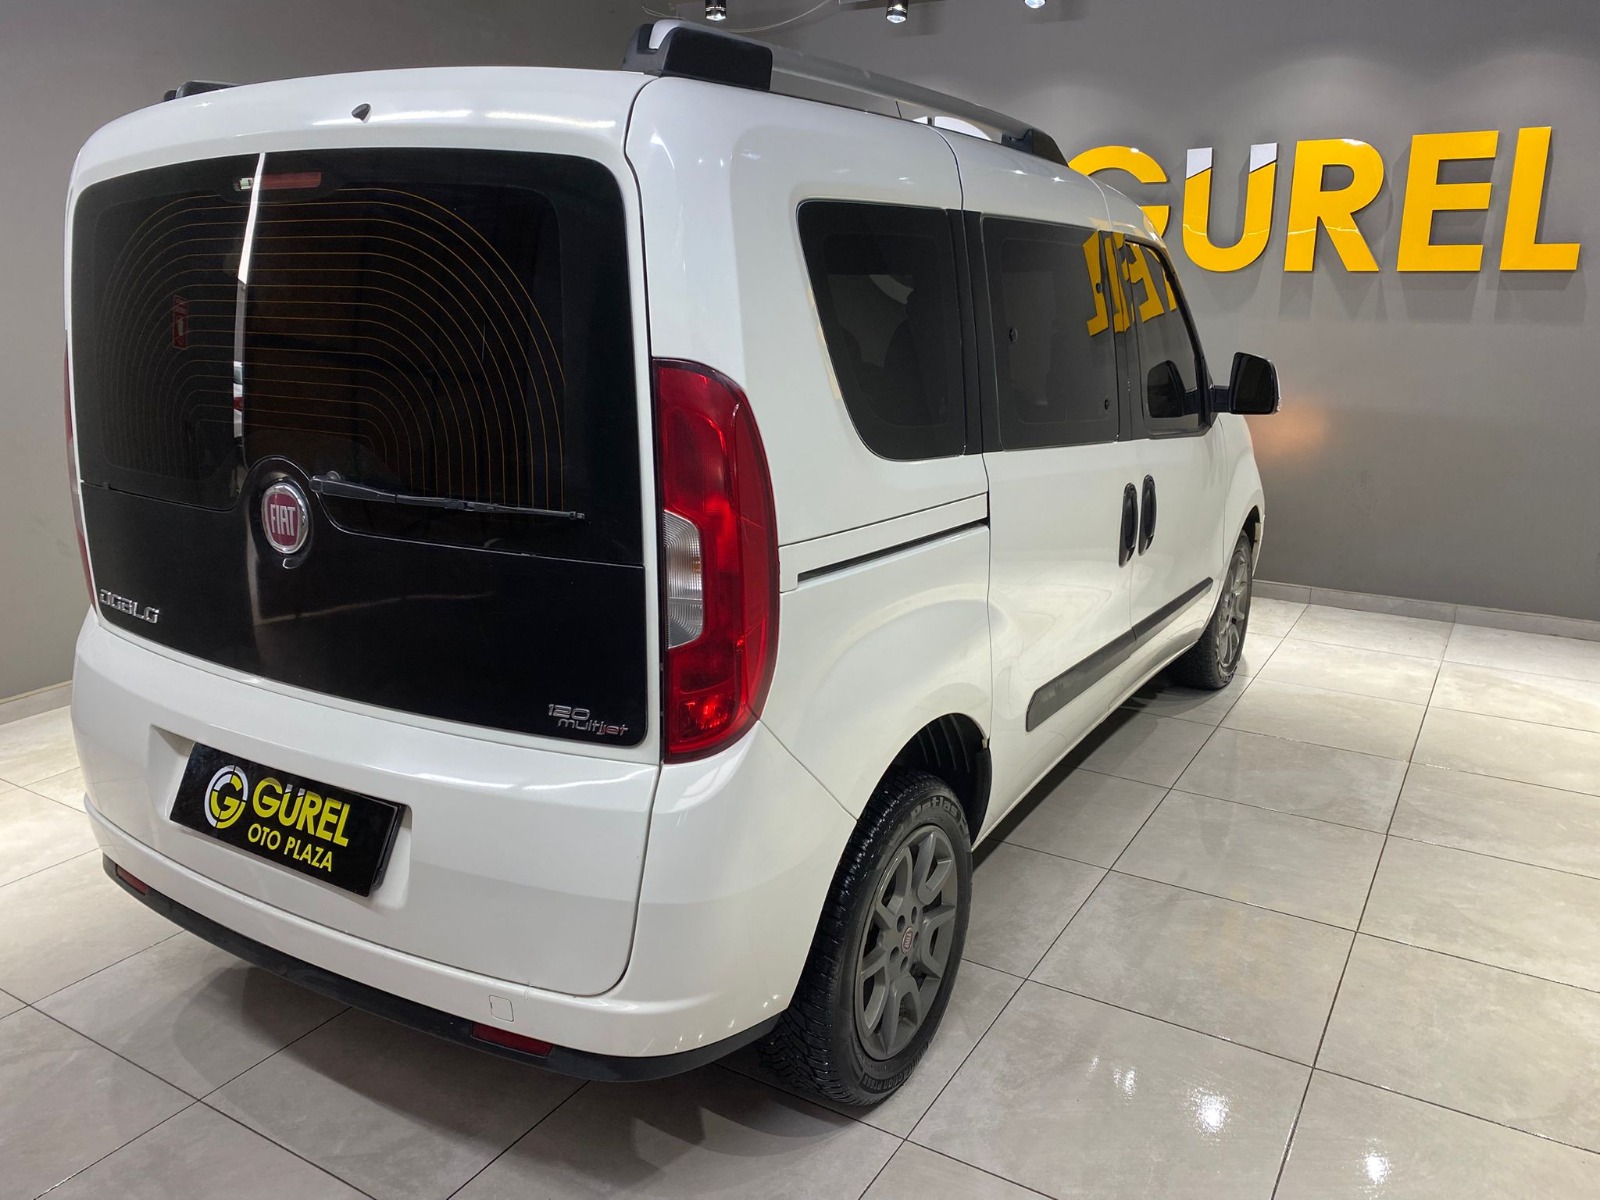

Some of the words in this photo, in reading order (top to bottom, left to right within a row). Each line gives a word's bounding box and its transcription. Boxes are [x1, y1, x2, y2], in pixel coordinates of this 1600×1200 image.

[269, 504, 296, 537] FIAT
[548, 704, 591, 721] 120
[557, 719, 629, 736] multijet
[252, 777, 351, 847] GÜREL
[247, 823, 281, 850] OTO
[283, 836, 333, 872] PLAZA
